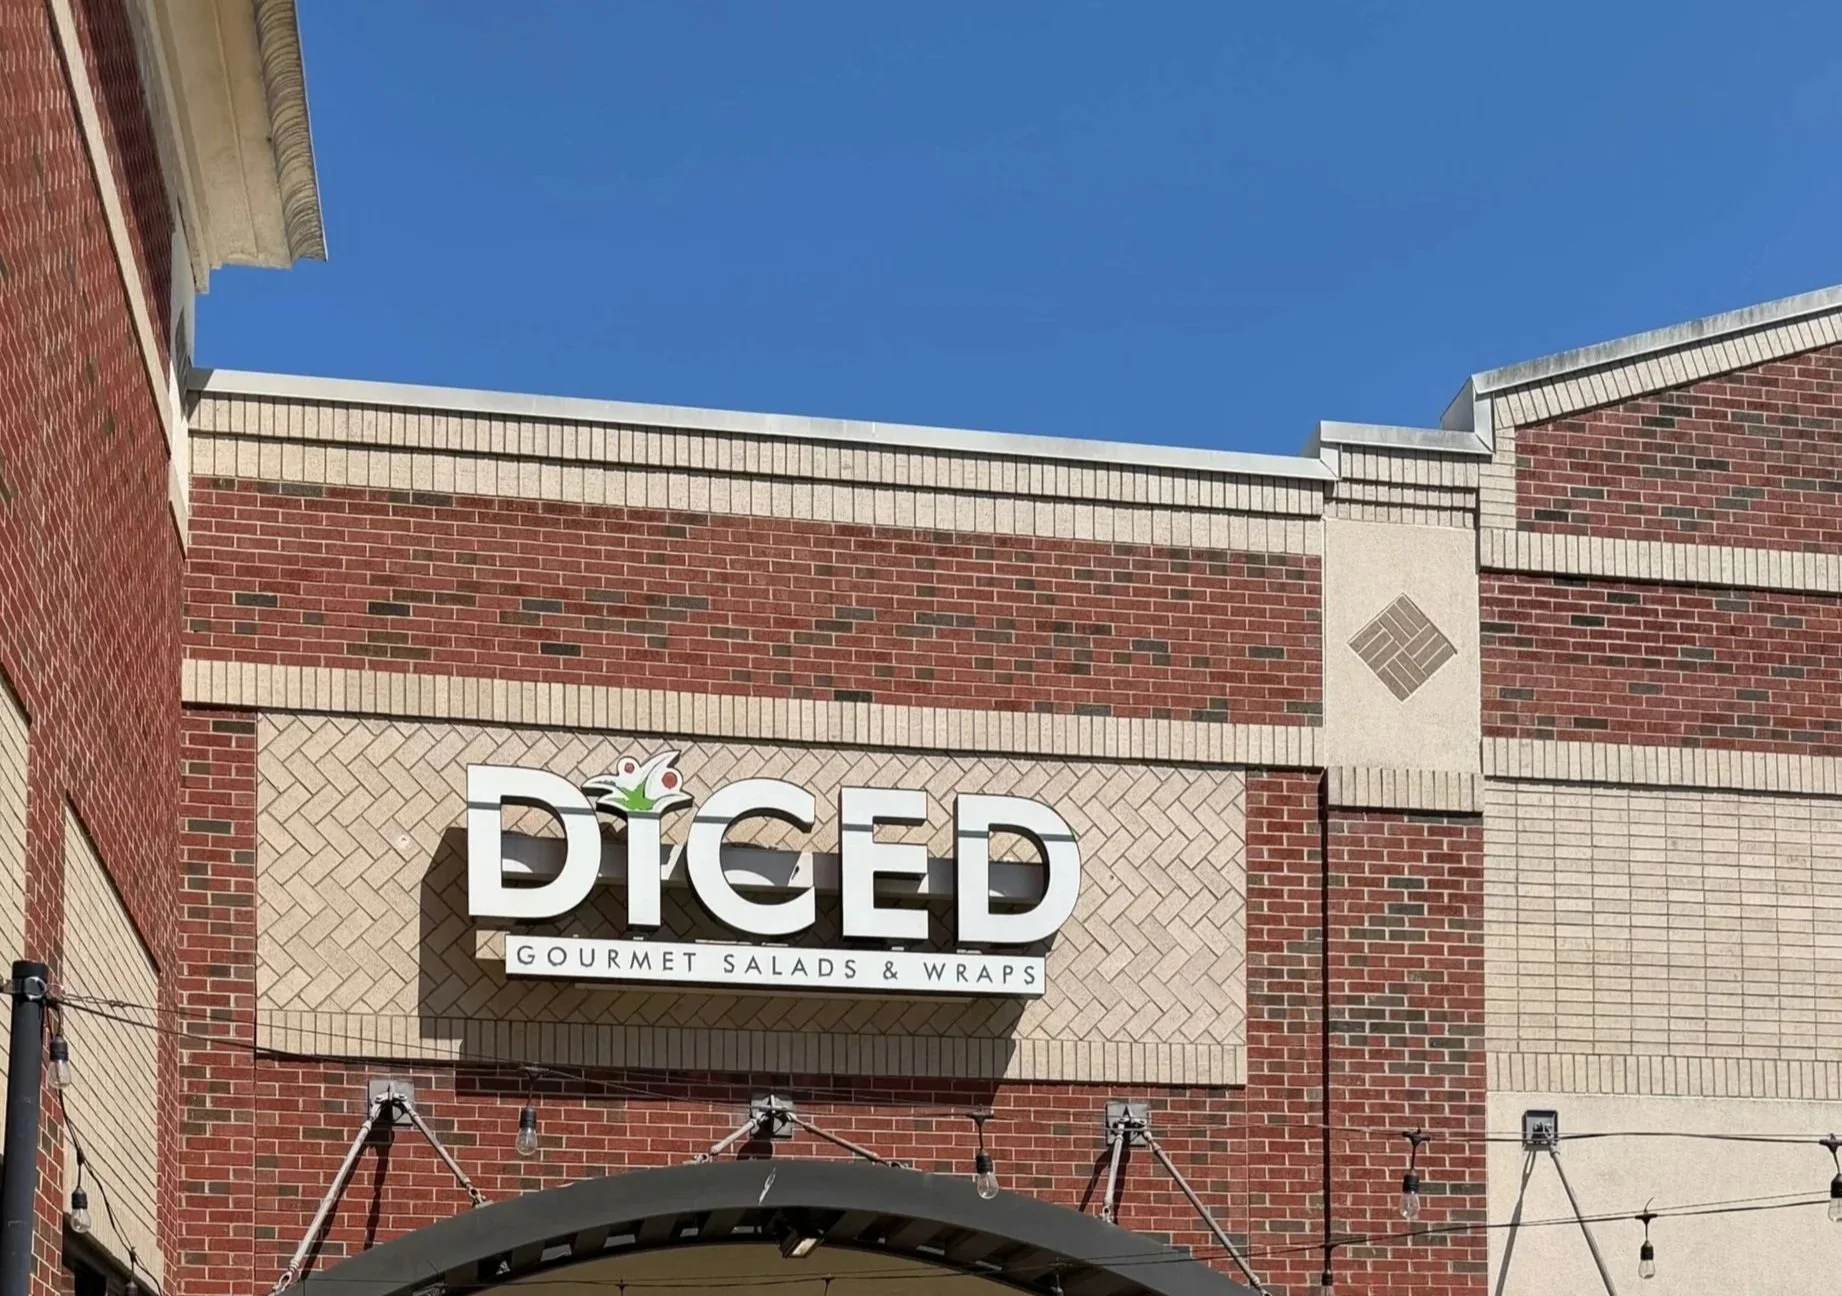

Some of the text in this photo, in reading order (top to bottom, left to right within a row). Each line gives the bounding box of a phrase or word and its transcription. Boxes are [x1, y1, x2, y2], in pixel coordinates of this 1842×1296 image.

[466, 752, 1082, 944] DICED
[516, 944, 1037, 986] GOURMET SALADS & WRAPS
